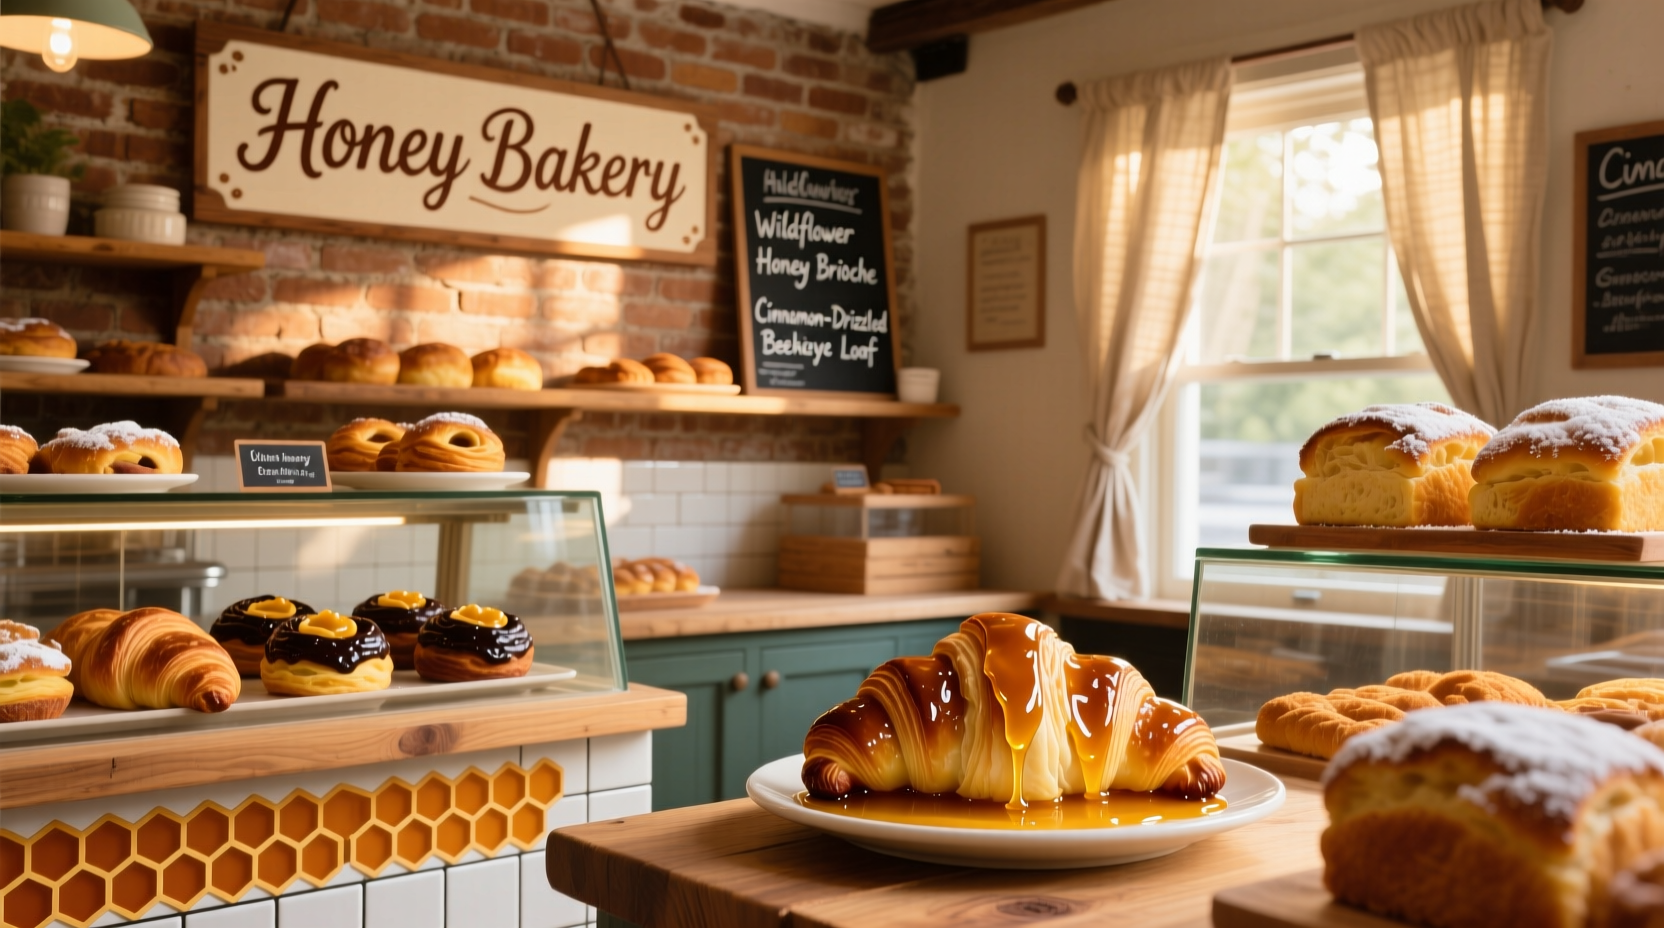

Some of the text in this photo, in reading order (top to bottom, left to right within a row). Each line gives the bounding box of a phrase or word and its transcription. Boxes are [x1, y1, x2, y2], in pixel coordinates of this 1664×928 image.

[237, 77, 686, 232] Honey Bakery
[754, 209, 855, 249] Wildflower
[756, 246, 878, 290] Honey Brioche
[840, 334, 879, 368] Loaf
